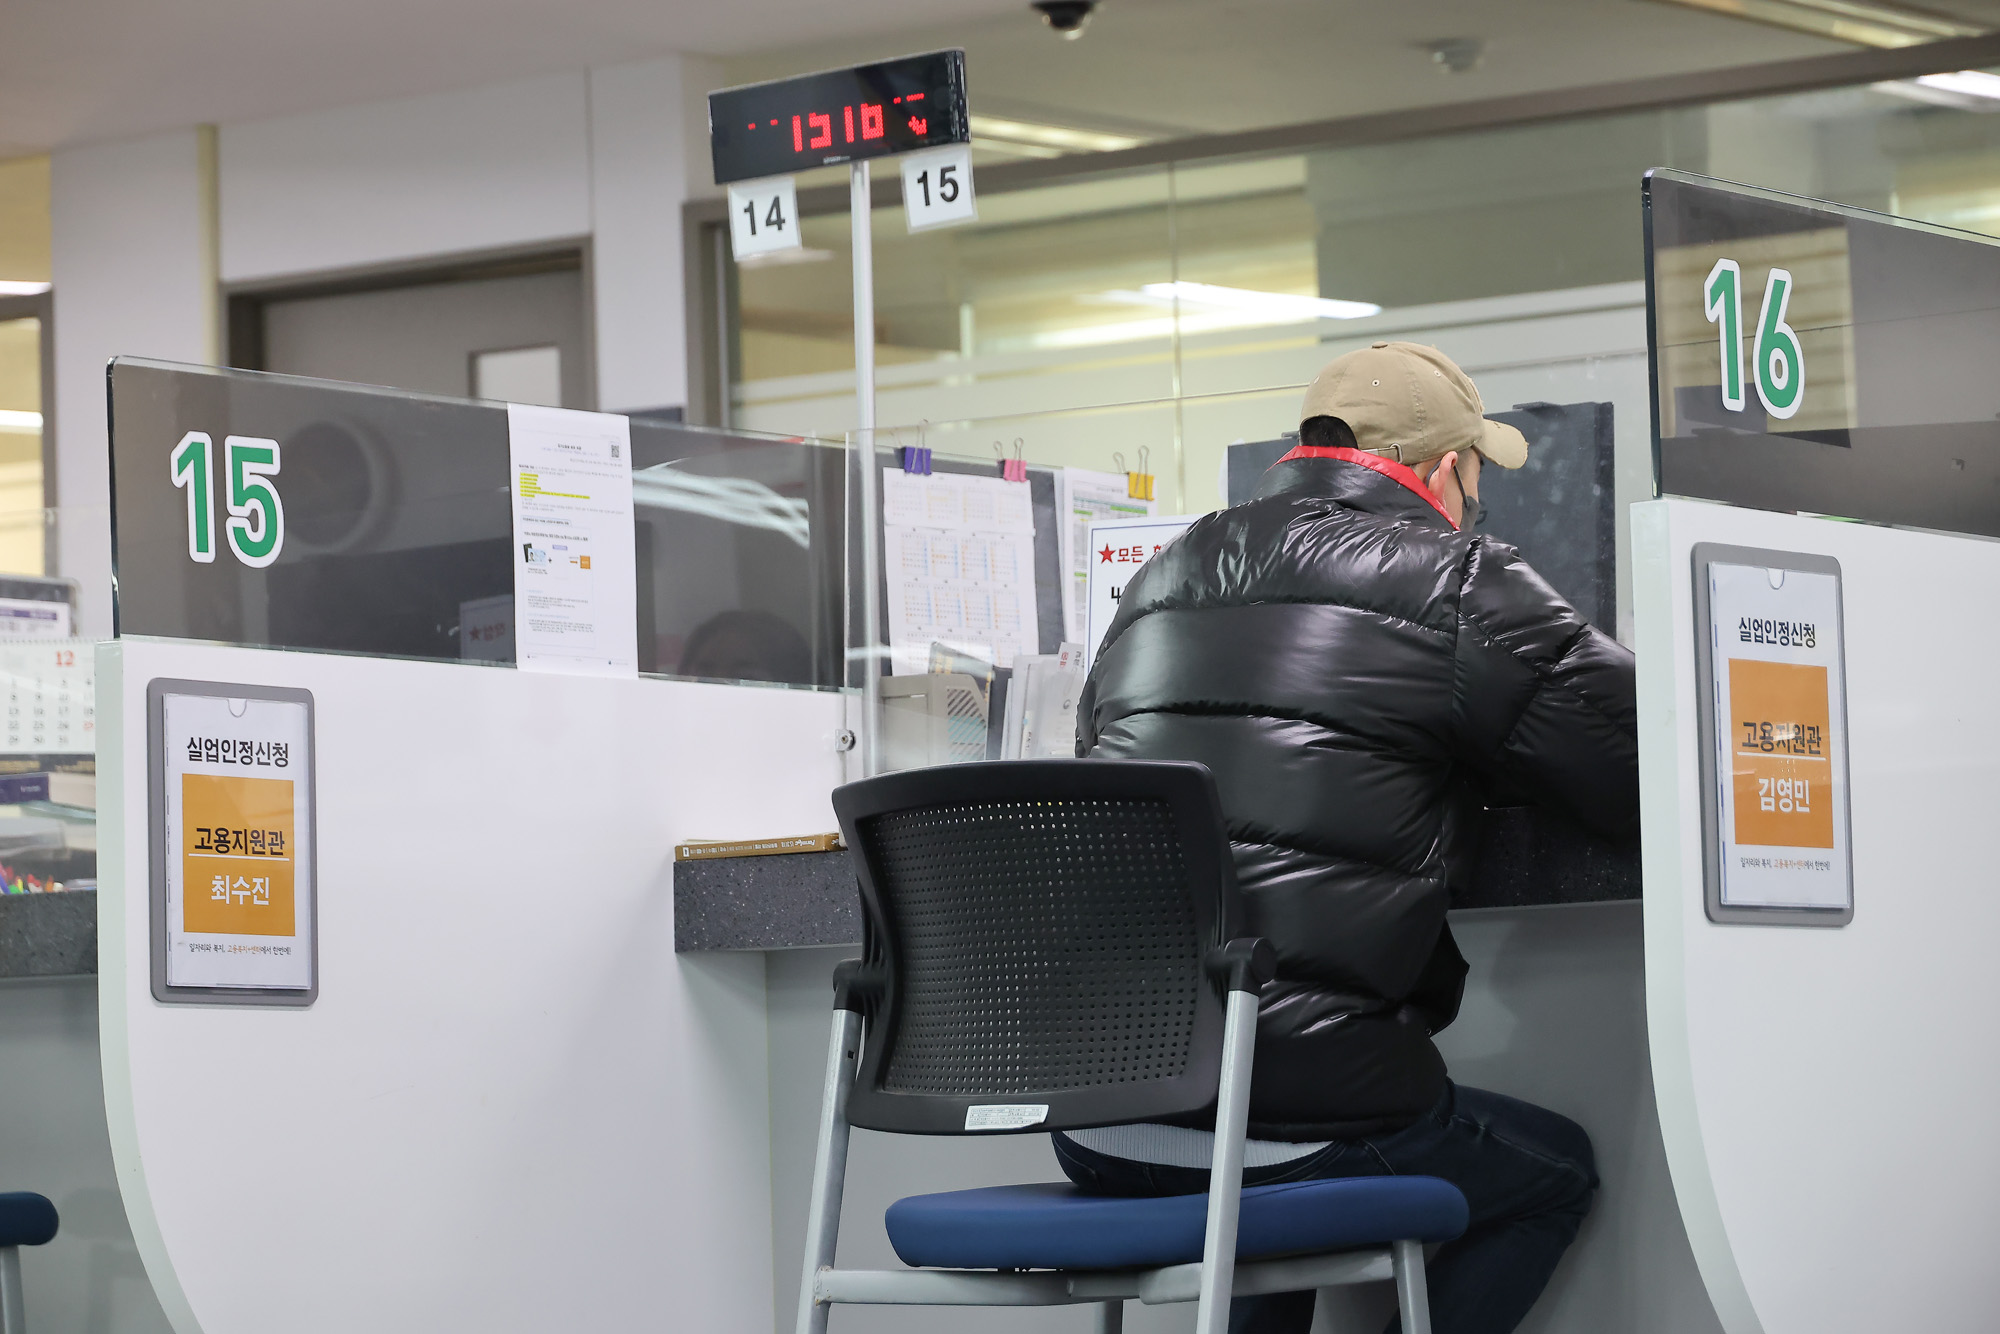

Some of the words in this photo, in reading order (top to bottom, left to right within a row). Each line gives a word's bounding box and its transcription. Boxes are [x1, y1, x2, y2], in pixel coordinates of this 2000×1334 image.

[917, 165, 960, 207] 15
[743, 196, 786, 236] 14
[1704, 257, 1805, 419] 16
[171, 430, 284, 568] 15
[1117, 545, 1144, 563] 모든
[1738, 617, 1816, 649] 실업인정신청
[56, 650, 75, 667] 12
[187, 737, 289, 768] 실업인정신청
[1742, 721, 1822, 755] 고용지원관
[1757, 777, 1810, 813] 김영민
[194, 827, 285, 855] 고용지원관
[211, 874, 270, 906] 최수진
